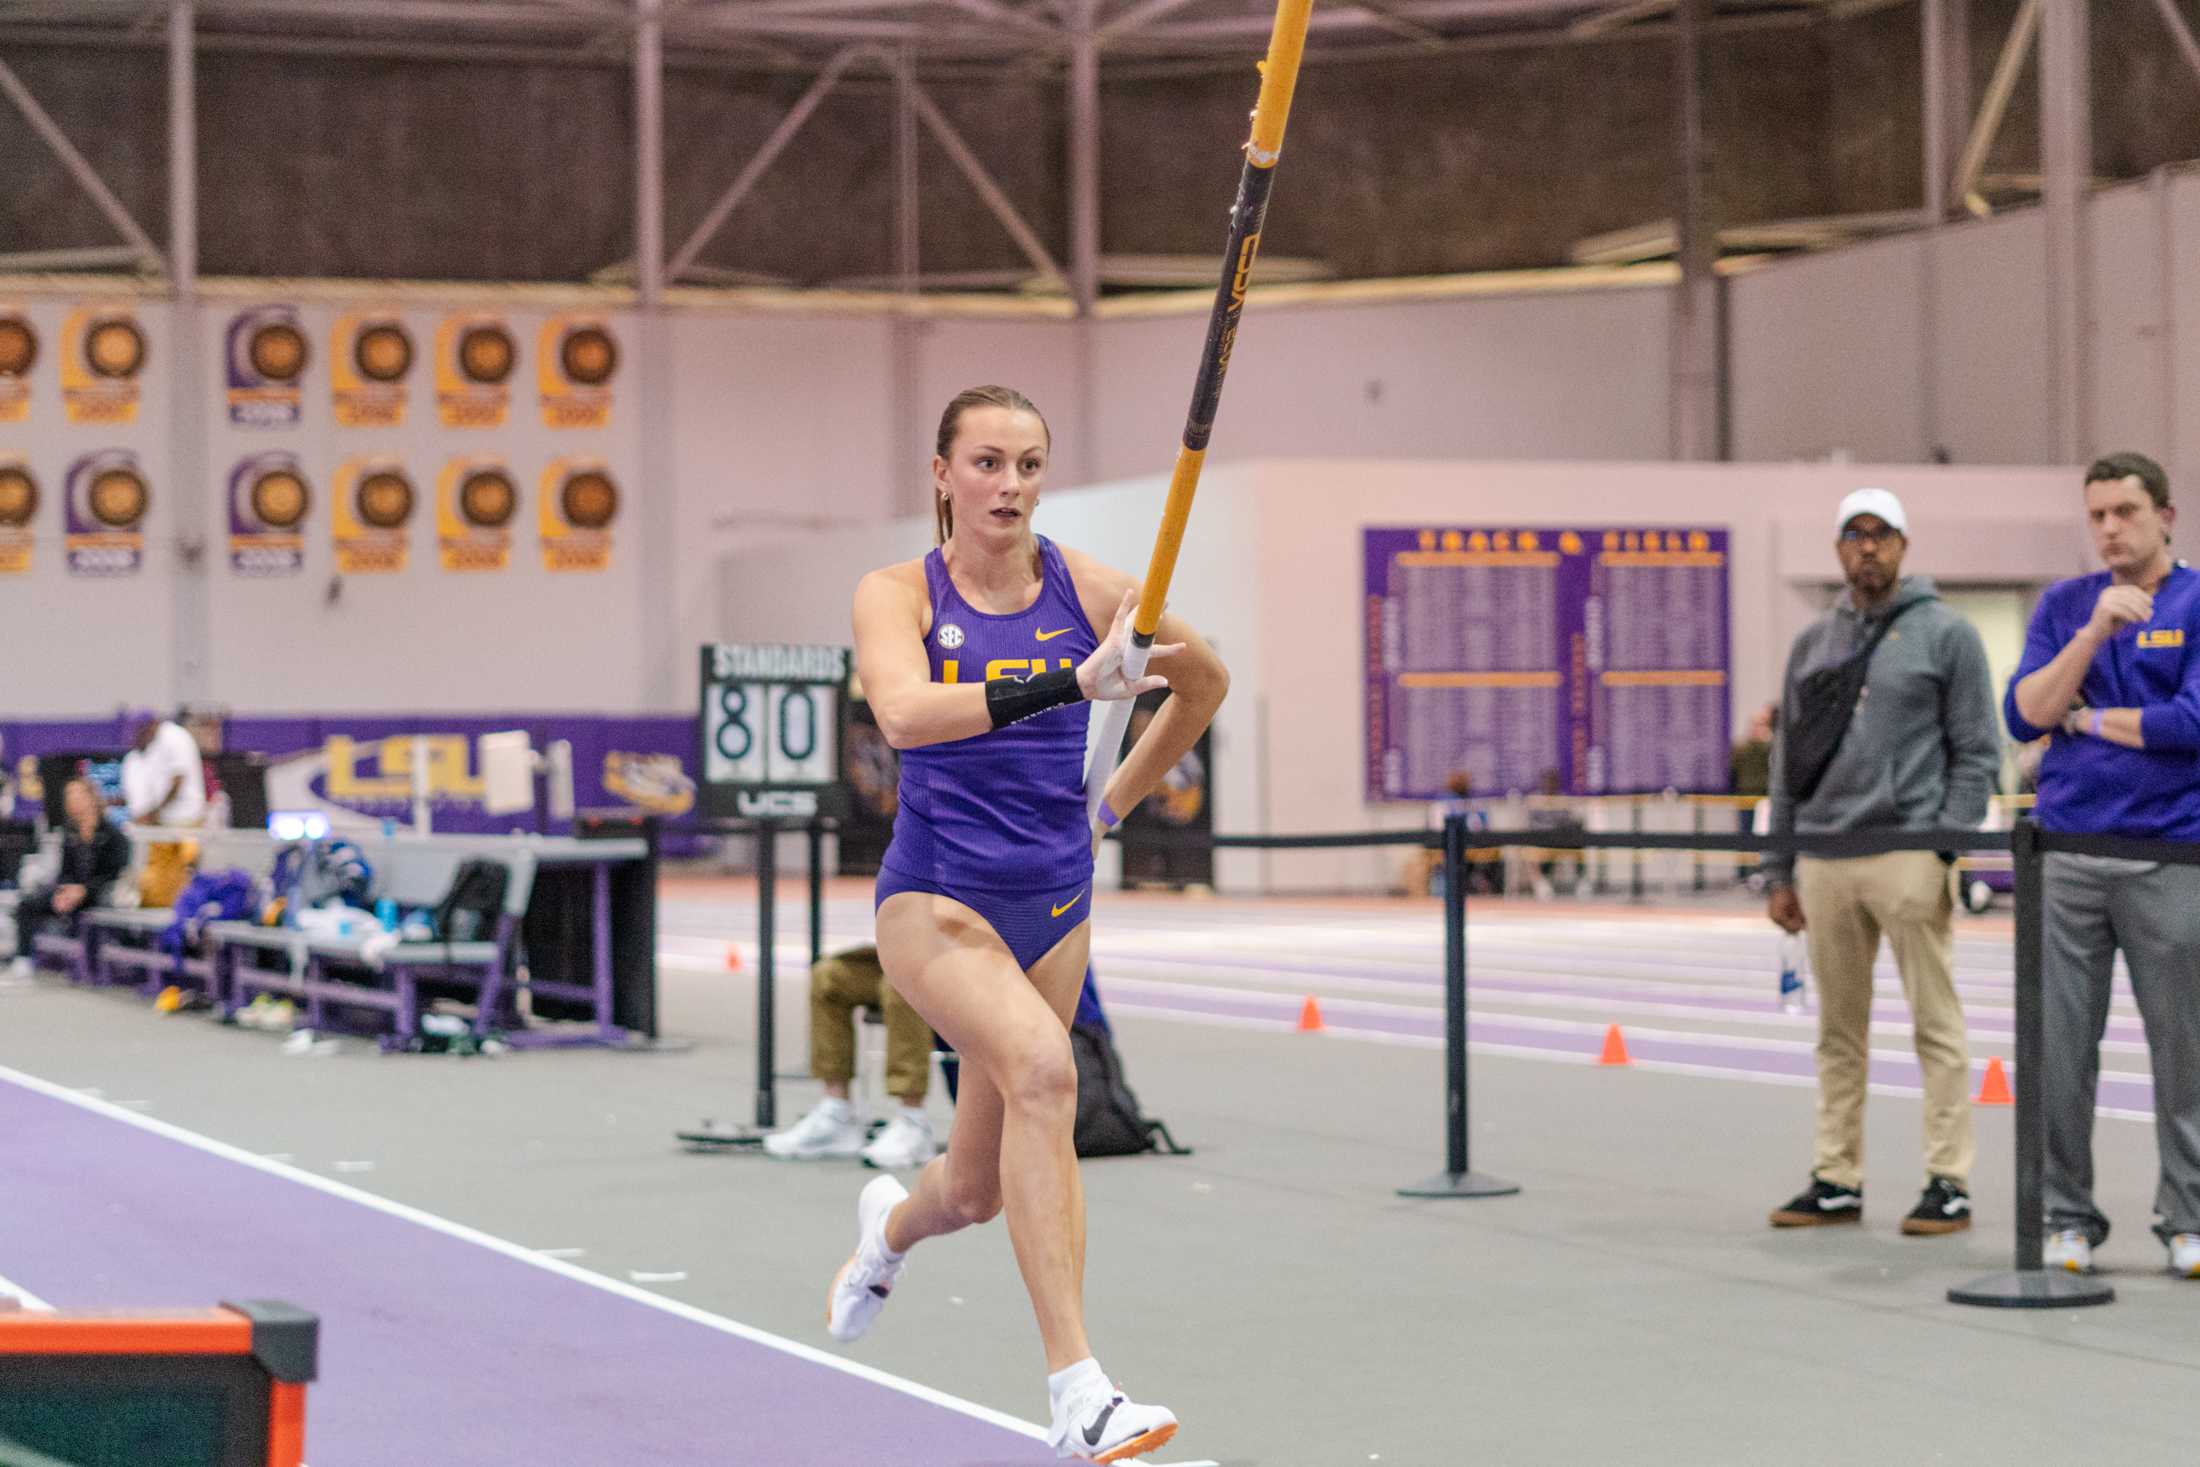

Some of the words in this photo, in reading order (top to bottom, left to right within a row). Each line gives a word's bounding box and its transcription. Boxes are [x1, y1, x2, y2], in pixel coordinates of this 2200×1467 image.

[939, 628, 964, 646] SEC
[2136, 629, 2184, 648] LSU
[713, 644, 846, 682] STANDARDS
[943, 658, 1072, 684] LS
